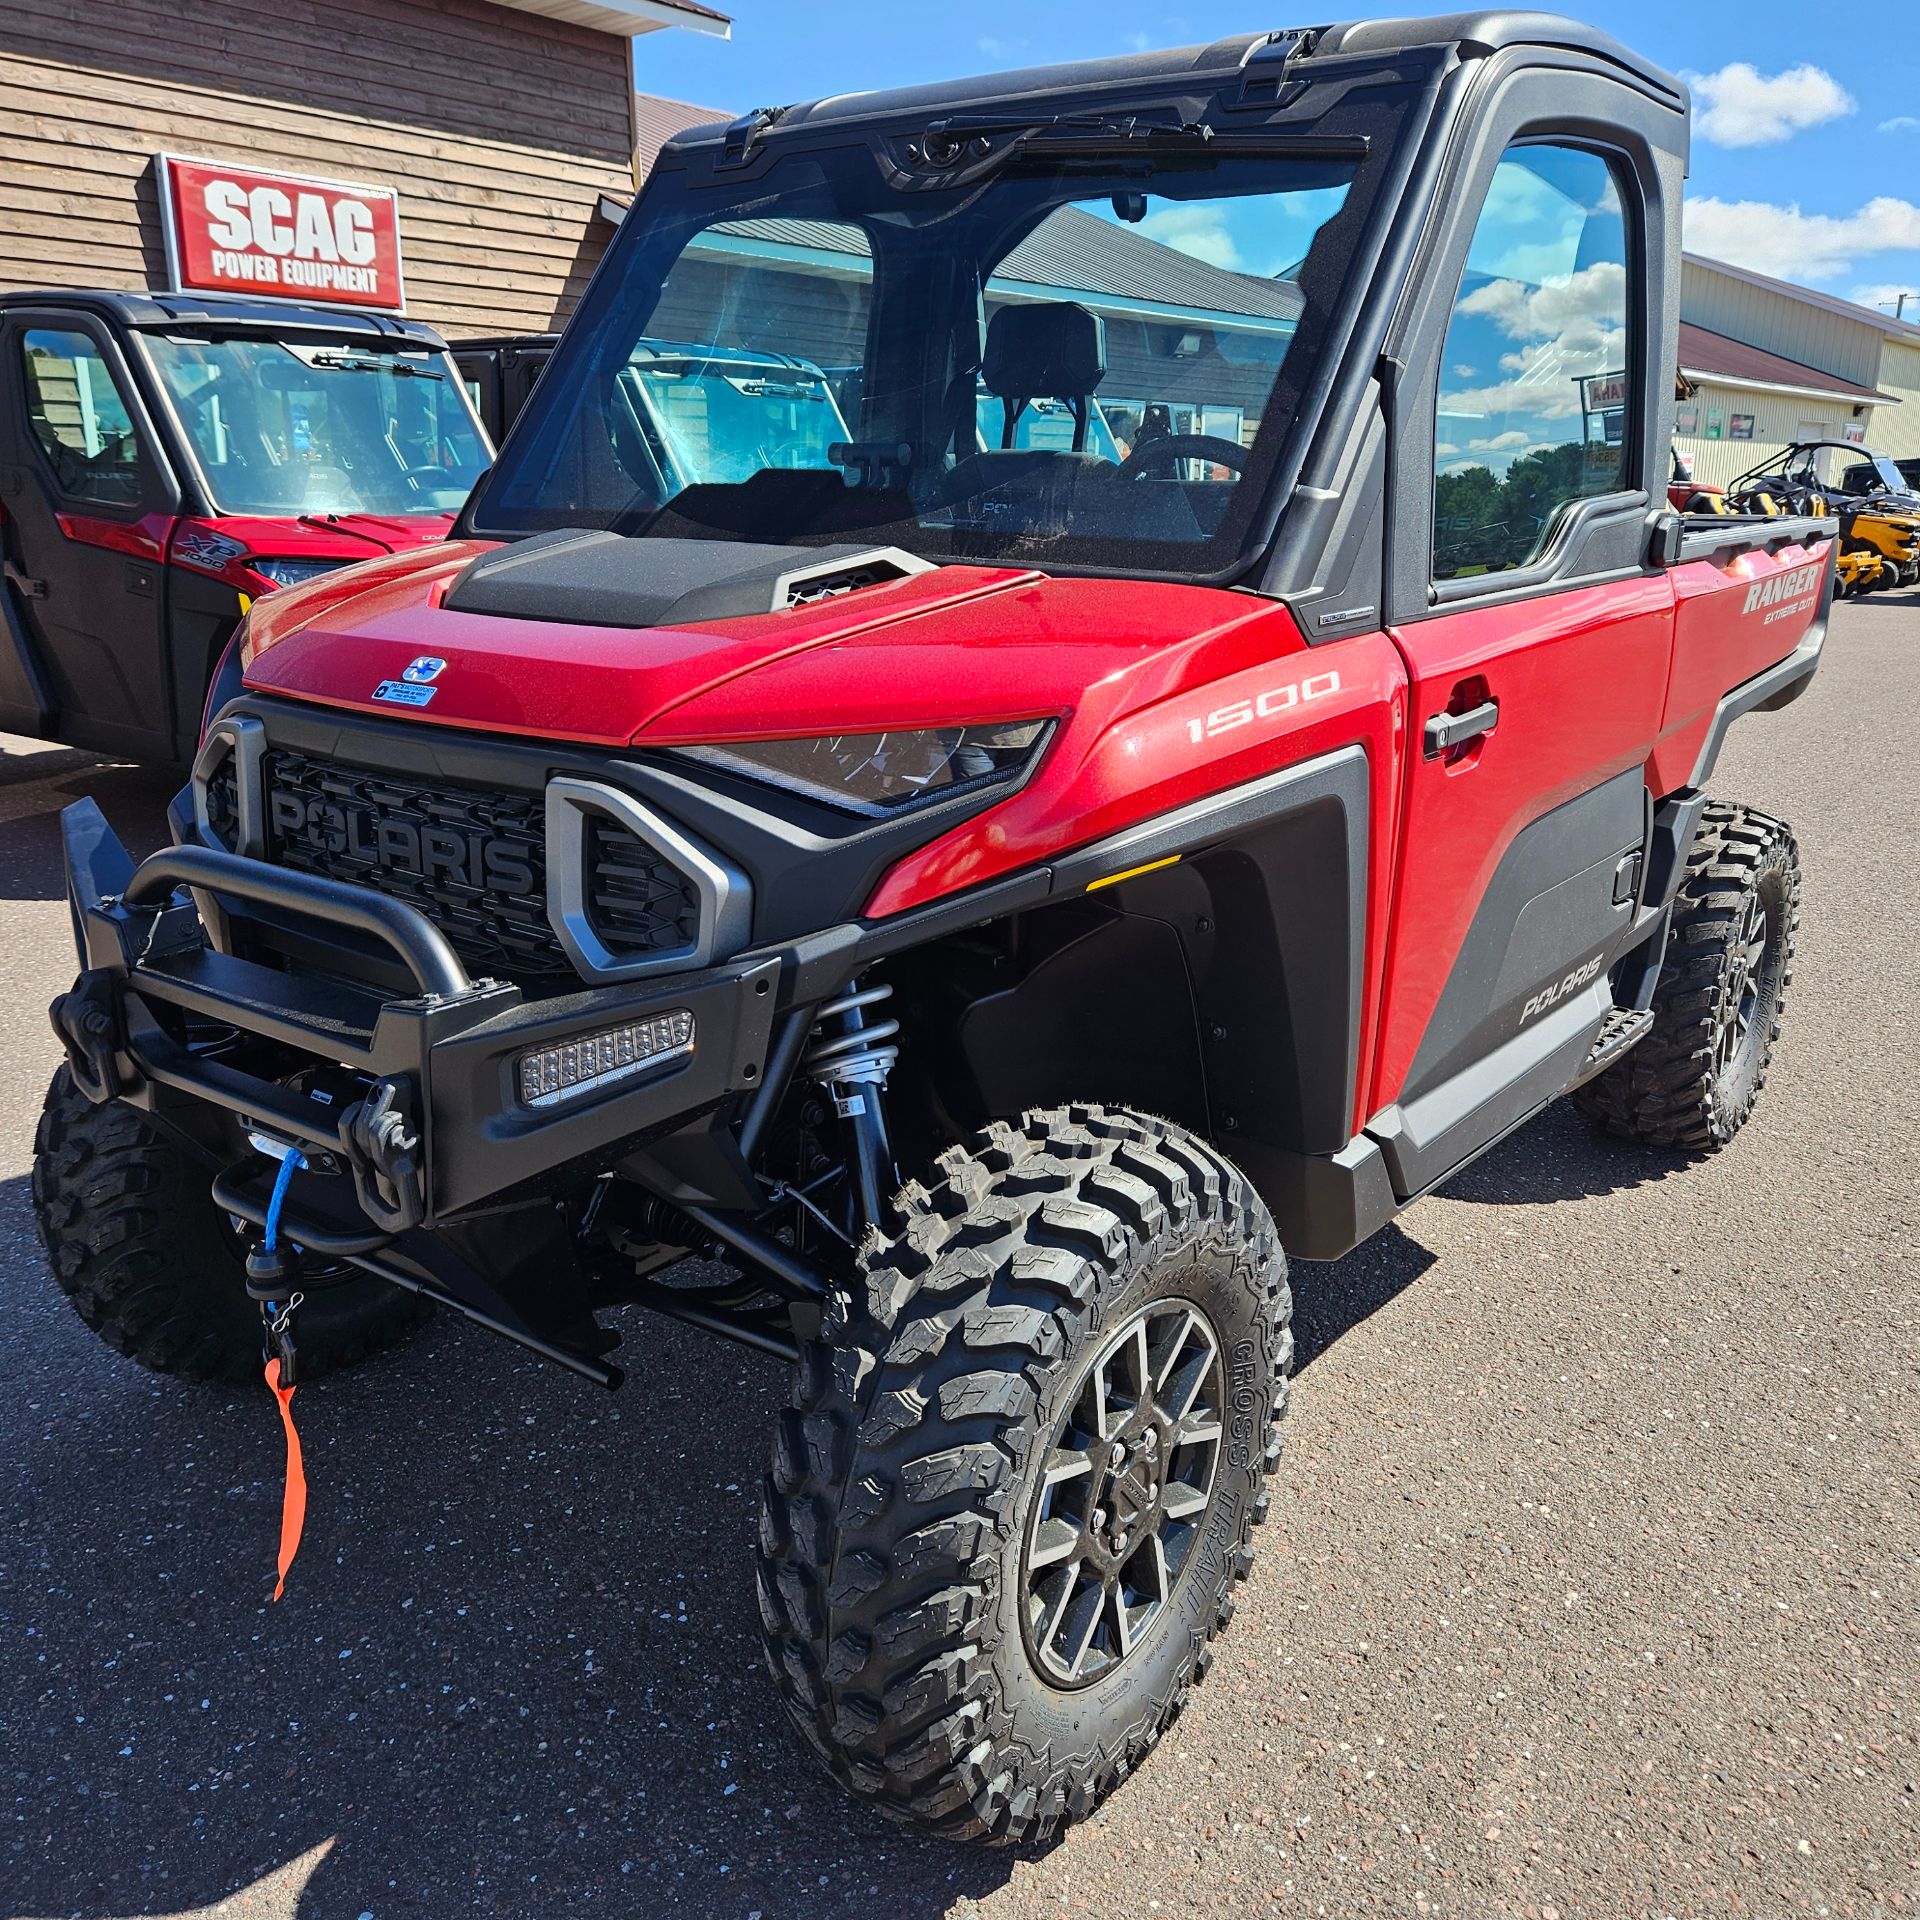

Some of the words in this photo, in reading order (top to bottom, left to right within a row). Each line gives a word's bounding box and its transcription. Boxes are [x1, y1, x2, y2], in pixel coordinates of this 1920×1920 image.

[203, 179, 377, 266] SCAG
[211, 249, 280, 284] POWER
[280, 257, 379, 295] EQUIPMENT
[175, 533, 239, 559] XP
[185, 550, 226, 570] 1000
[1741, 564, 1819, 615] RANGER
[1763, 602, 1799, 625] EXTREME
[1797, 595, 1815, 612] DUTY
[1186, 670, 1341, 744] 1500
[271, 787, 534, 895] POLARIS
[1518, 952, 1605, 1026] POLARIS
[1226, 1337, 1257, 1469] CROSS
[1187, 1488, 1242, 1617] TRAIL
